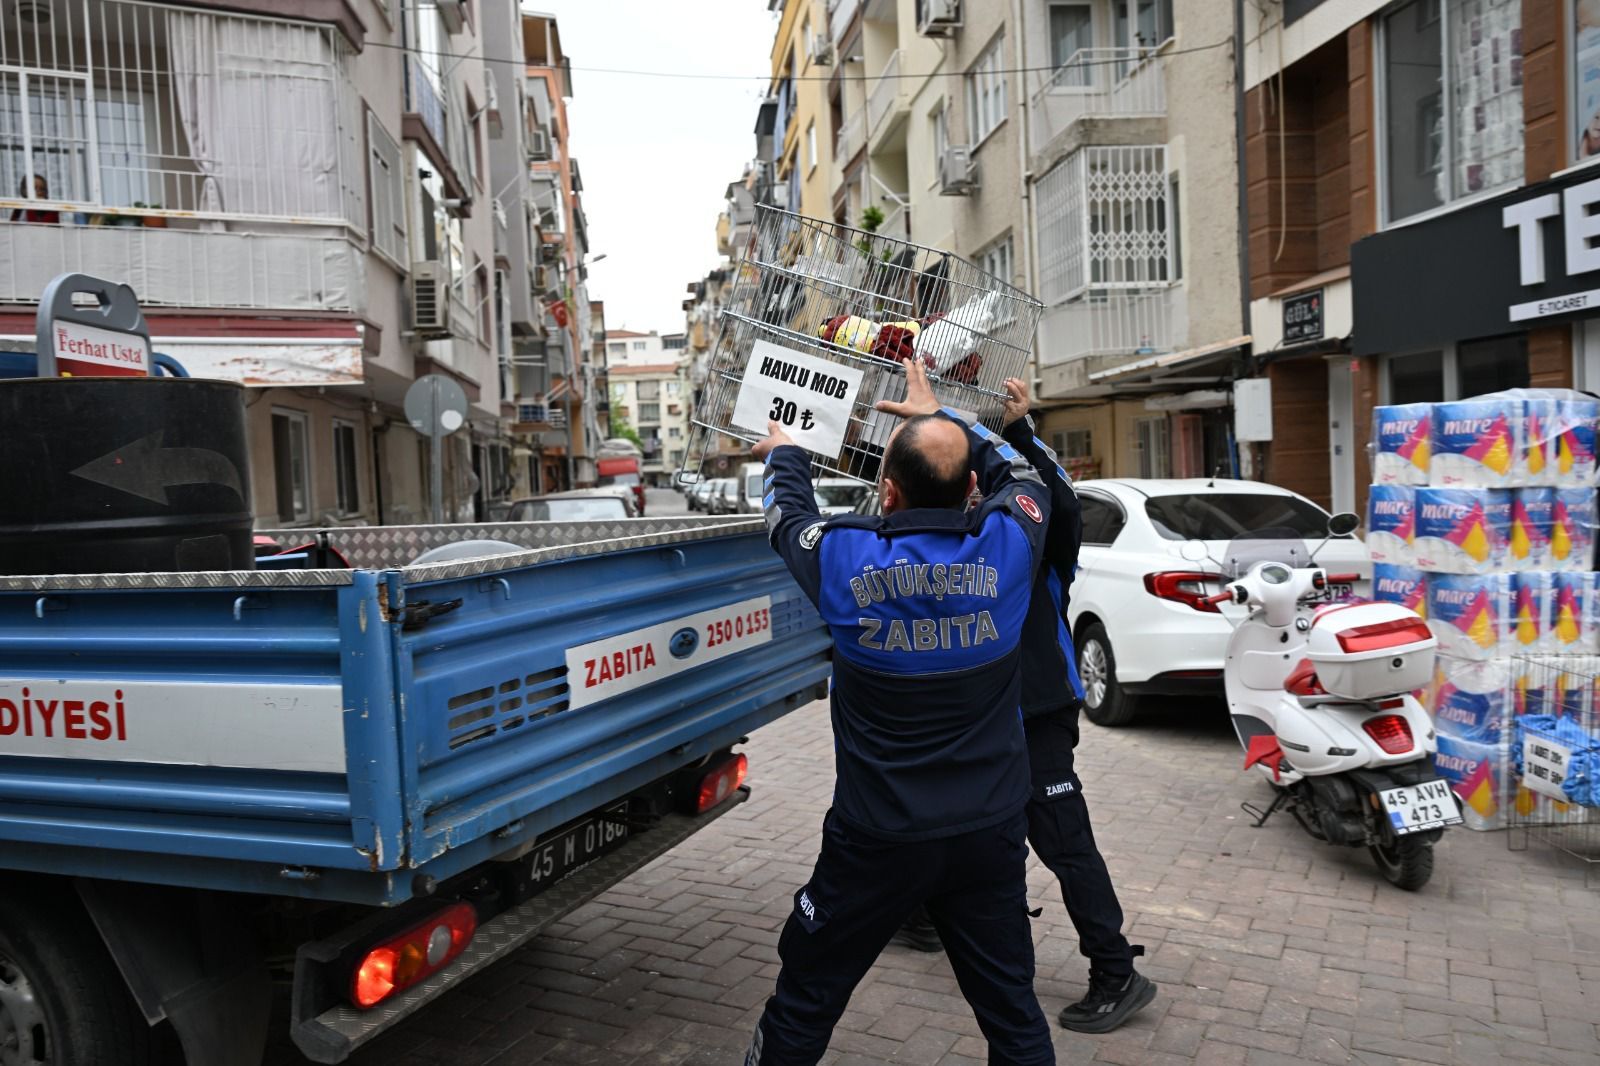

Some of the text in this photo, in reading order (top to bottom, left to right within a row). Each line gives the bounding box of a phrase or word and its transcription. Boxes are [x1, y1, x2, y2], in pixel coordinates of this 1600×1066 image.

[57, 333, 108, 359] Ferhat
[760, 356, 848, 400] HAVLU MOB
[769, 397, 797, 426] 30
[1444, 417, 1494, 436] mare
[1375, 500, 1411, 516] mare
[1422, 503, 1467, 520] mare
[850, 557, 998, 608] BÜYÜKŞEHİR
[1379, 578, 1416, 594] mare
[858, 611, 999, 652] ZABITA
[584, 643, 656, 688] ZABITA
[0, 687, 127, 741] DİYESİ
[1436, 752, 1477, 775] mare
[1045, 781, 1074, 797] ZABITA
[1387, 783, 1448, 807] 45 AVH
[1411, 804, 1443, 822] 473
[530, 845, 554, 882] 45
[563, 834, 576, 866] M
